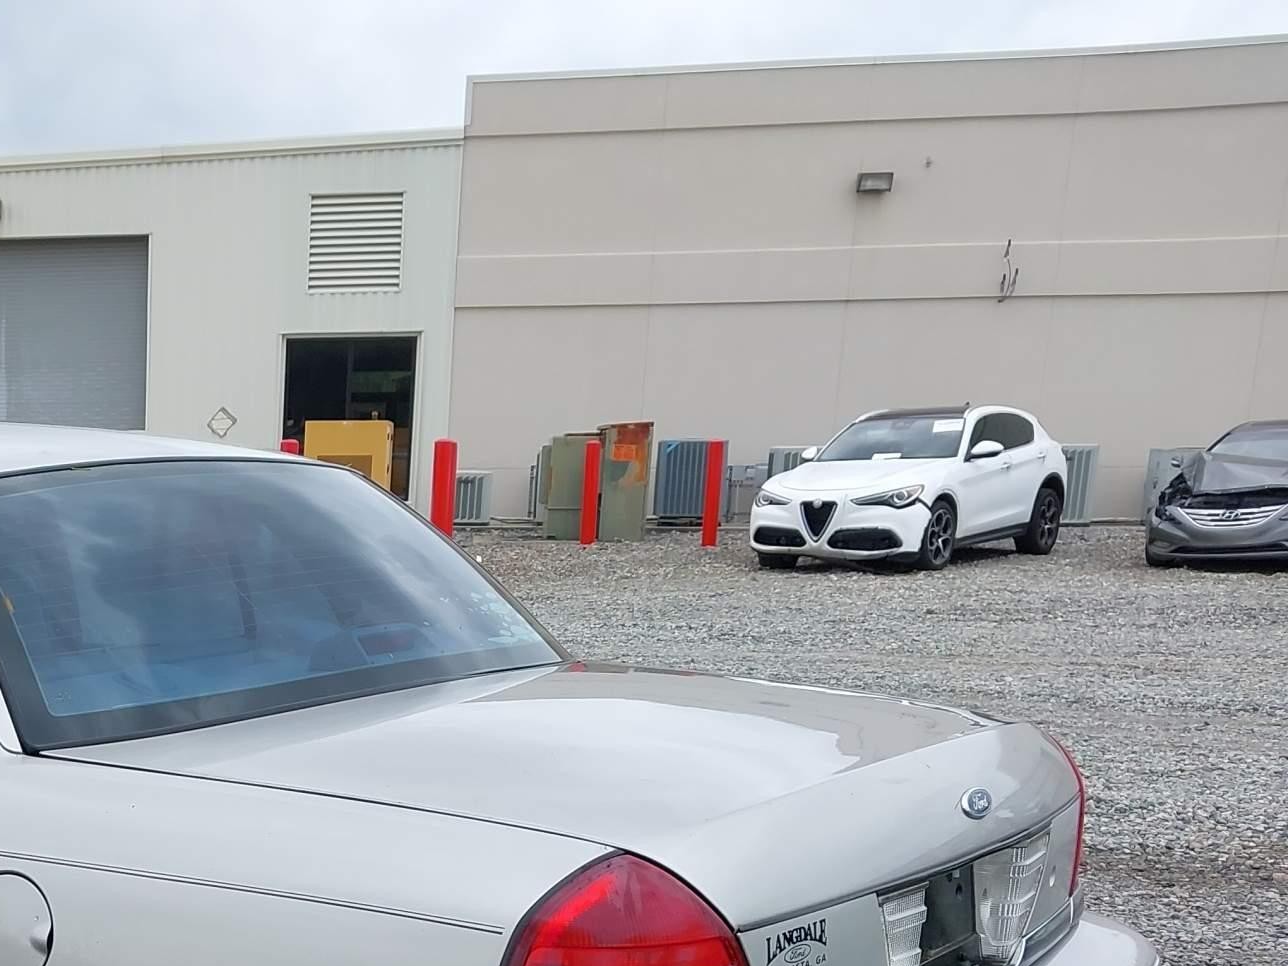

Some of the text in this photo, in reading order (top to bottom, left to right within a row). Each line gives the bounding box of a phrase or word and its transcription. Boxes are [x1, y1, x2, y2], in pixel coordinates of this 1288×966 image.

[765, 918, 828, 966] LANGDALE
[788, 946, 807, 961] Ford
[815, 953, 827, 965] GA
